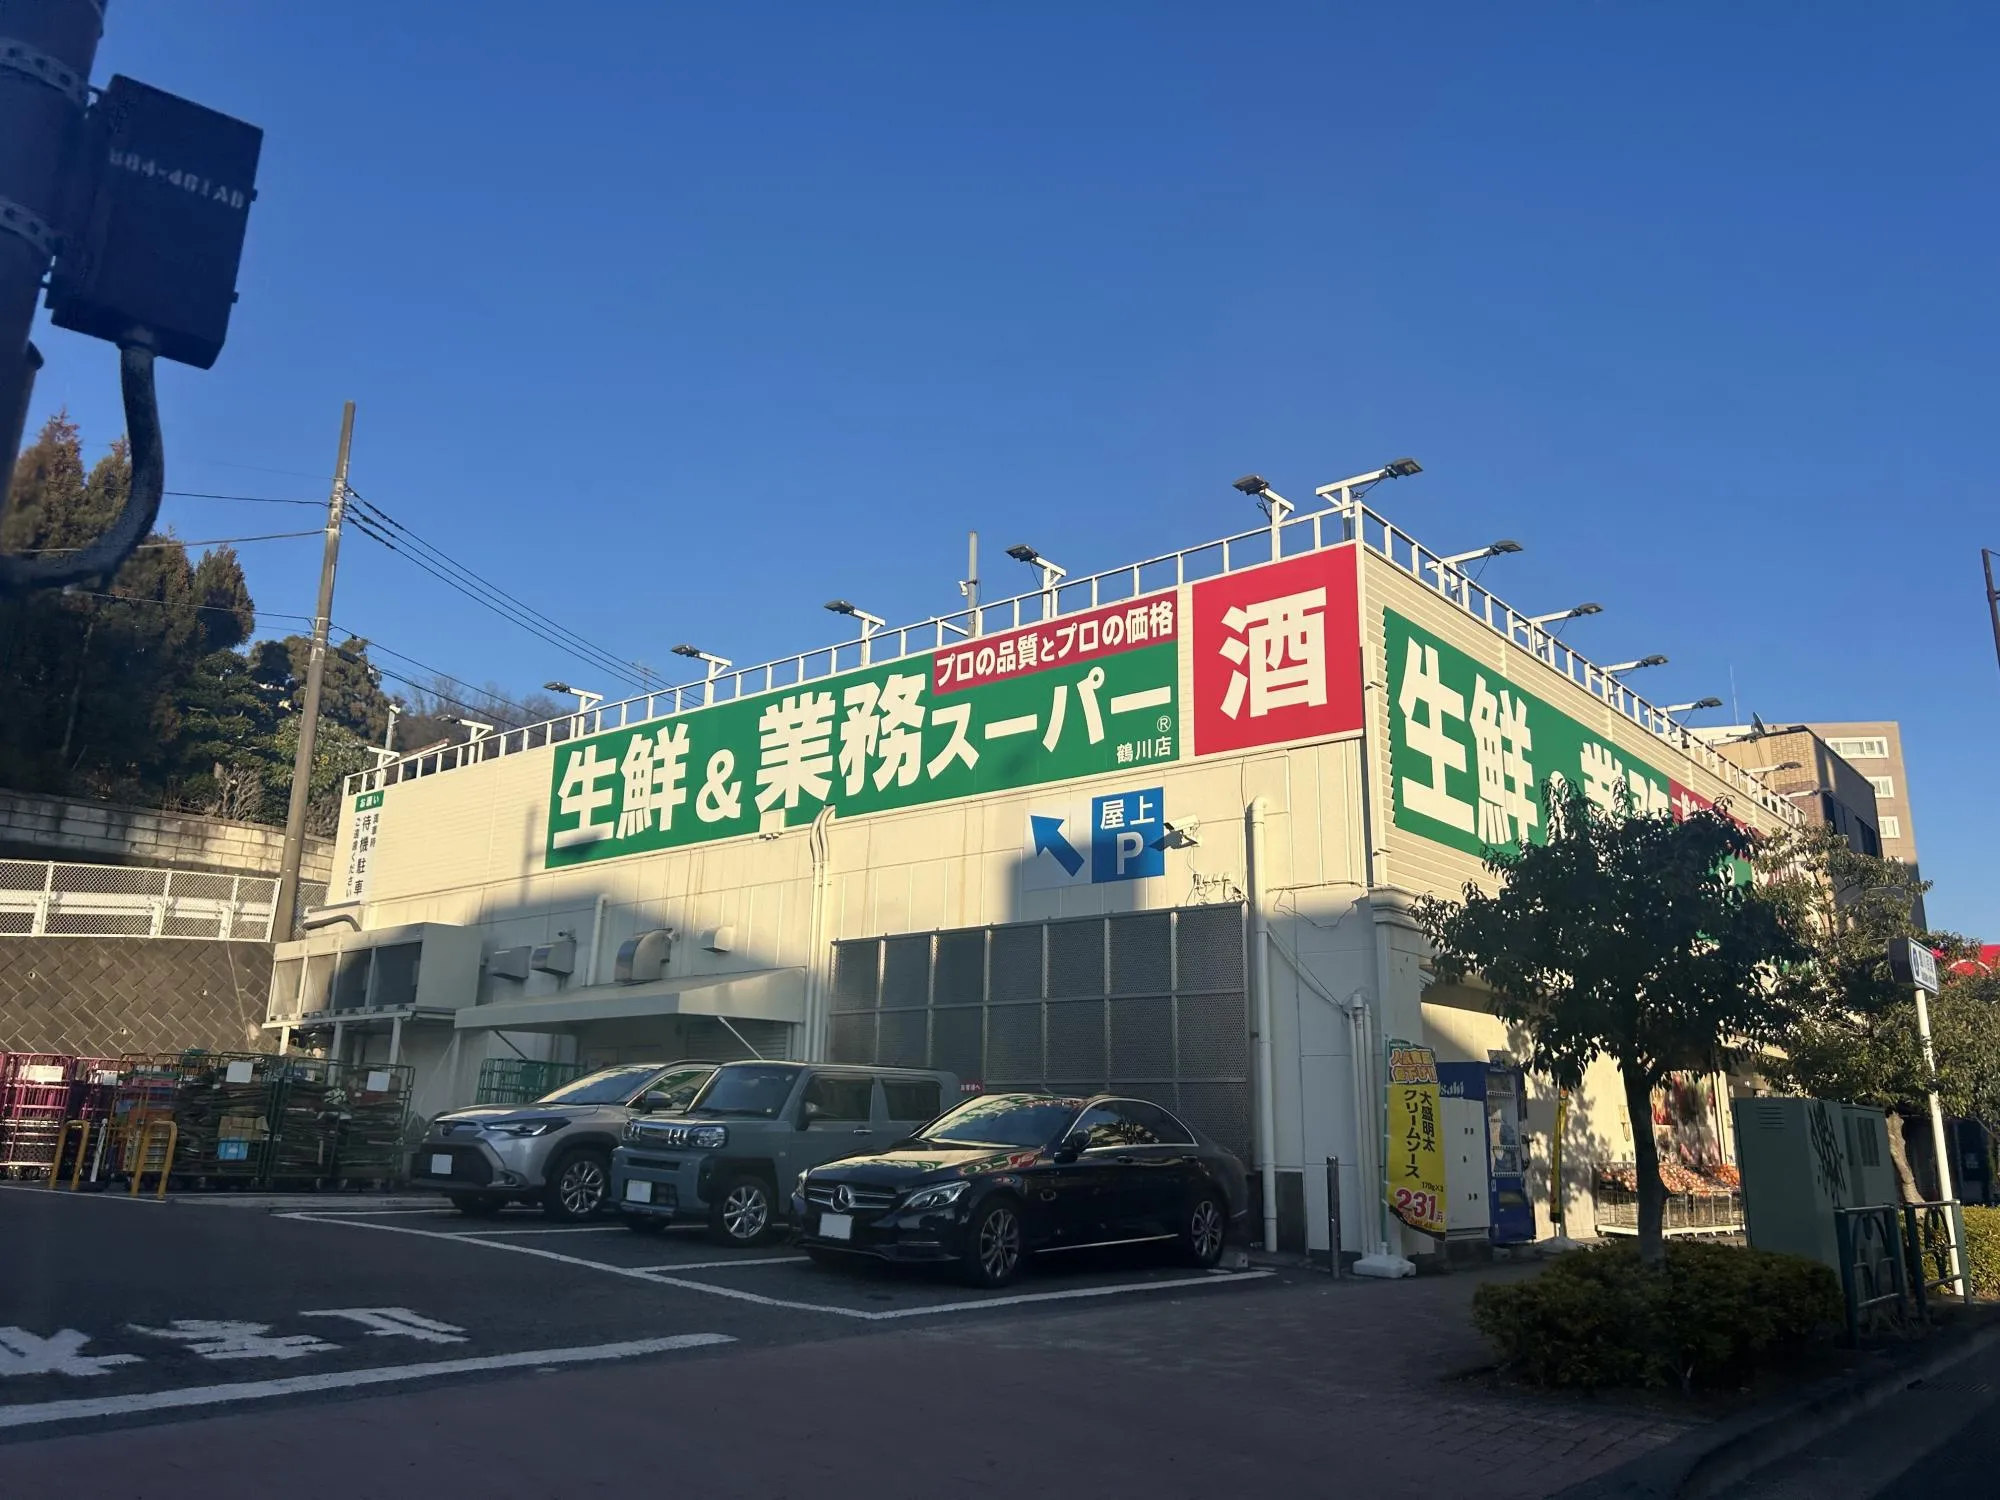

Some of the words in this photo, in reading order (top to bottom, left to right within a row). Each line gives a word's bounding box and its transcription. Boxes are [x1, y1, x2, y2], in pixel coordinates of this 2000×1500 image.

[936, 600, 1174, 687] プロの品質とプロの価格
[1218, 587, 1327, 720] 酒
[1116, 735, 1172, 764] 鶴川店
[1100, 796, 1155, 830] 屋上
[353, 815, 372, 896] 待機駐車
[1116, 833, 1143, 875] P
[1439, 1081, 1464, 1096] sahi
[1404, 1089, 1421, 1179] クリームソース
[1419, 1090, 1435, 1153] 大盛明太
